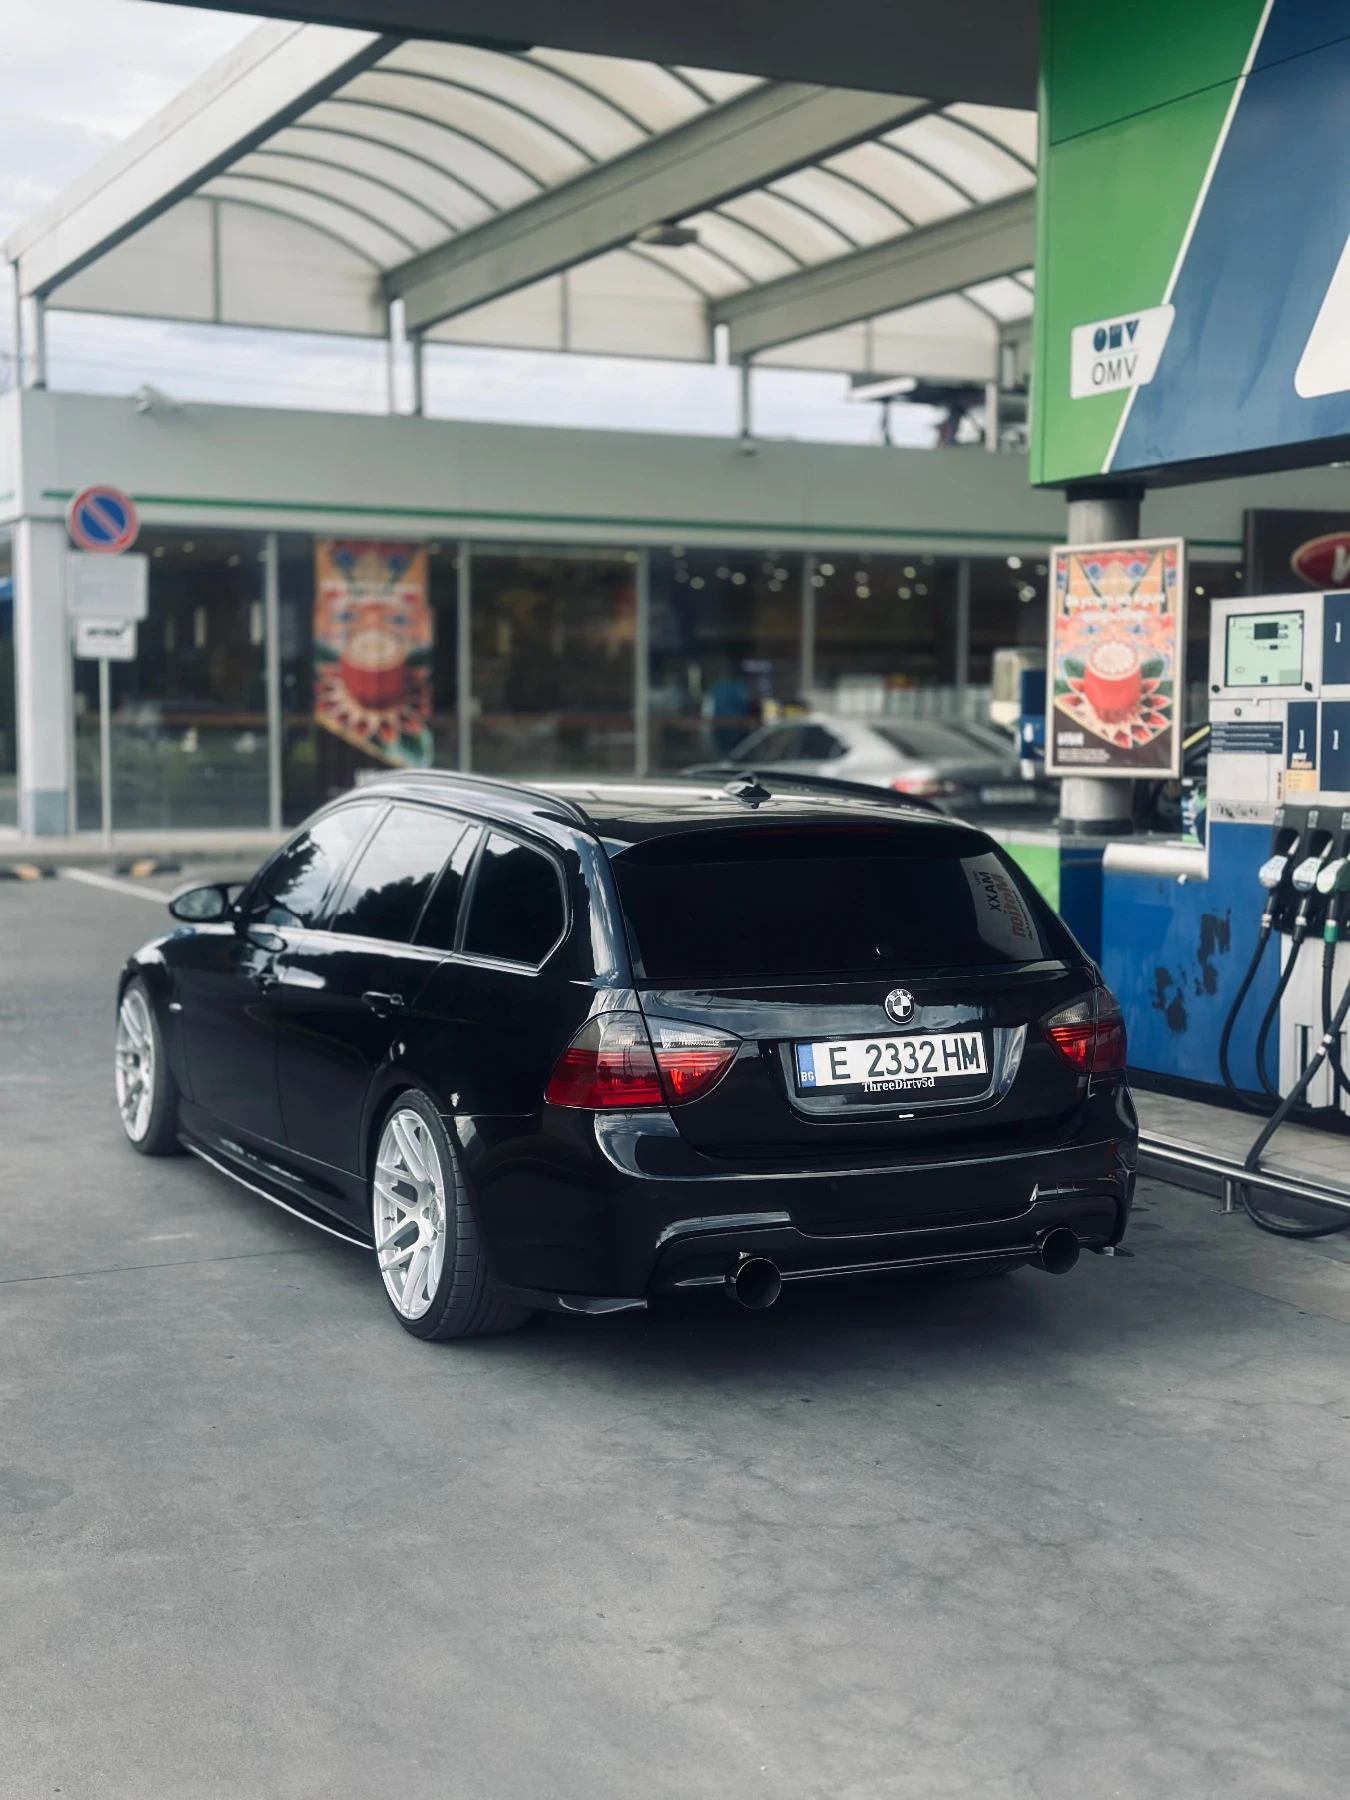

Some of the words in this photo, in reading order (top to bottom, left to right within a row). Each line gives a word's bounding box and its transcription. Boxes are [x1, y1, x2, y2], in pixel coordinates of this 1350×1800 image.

[1091, 354, 1138, 386] OMV
[829, 1047, 850, 1080] E
[865, 1041, 938, 1078] 2332
[942, 1037, 981, 1071] HM
[801, 1071, 815, 1082] BG
